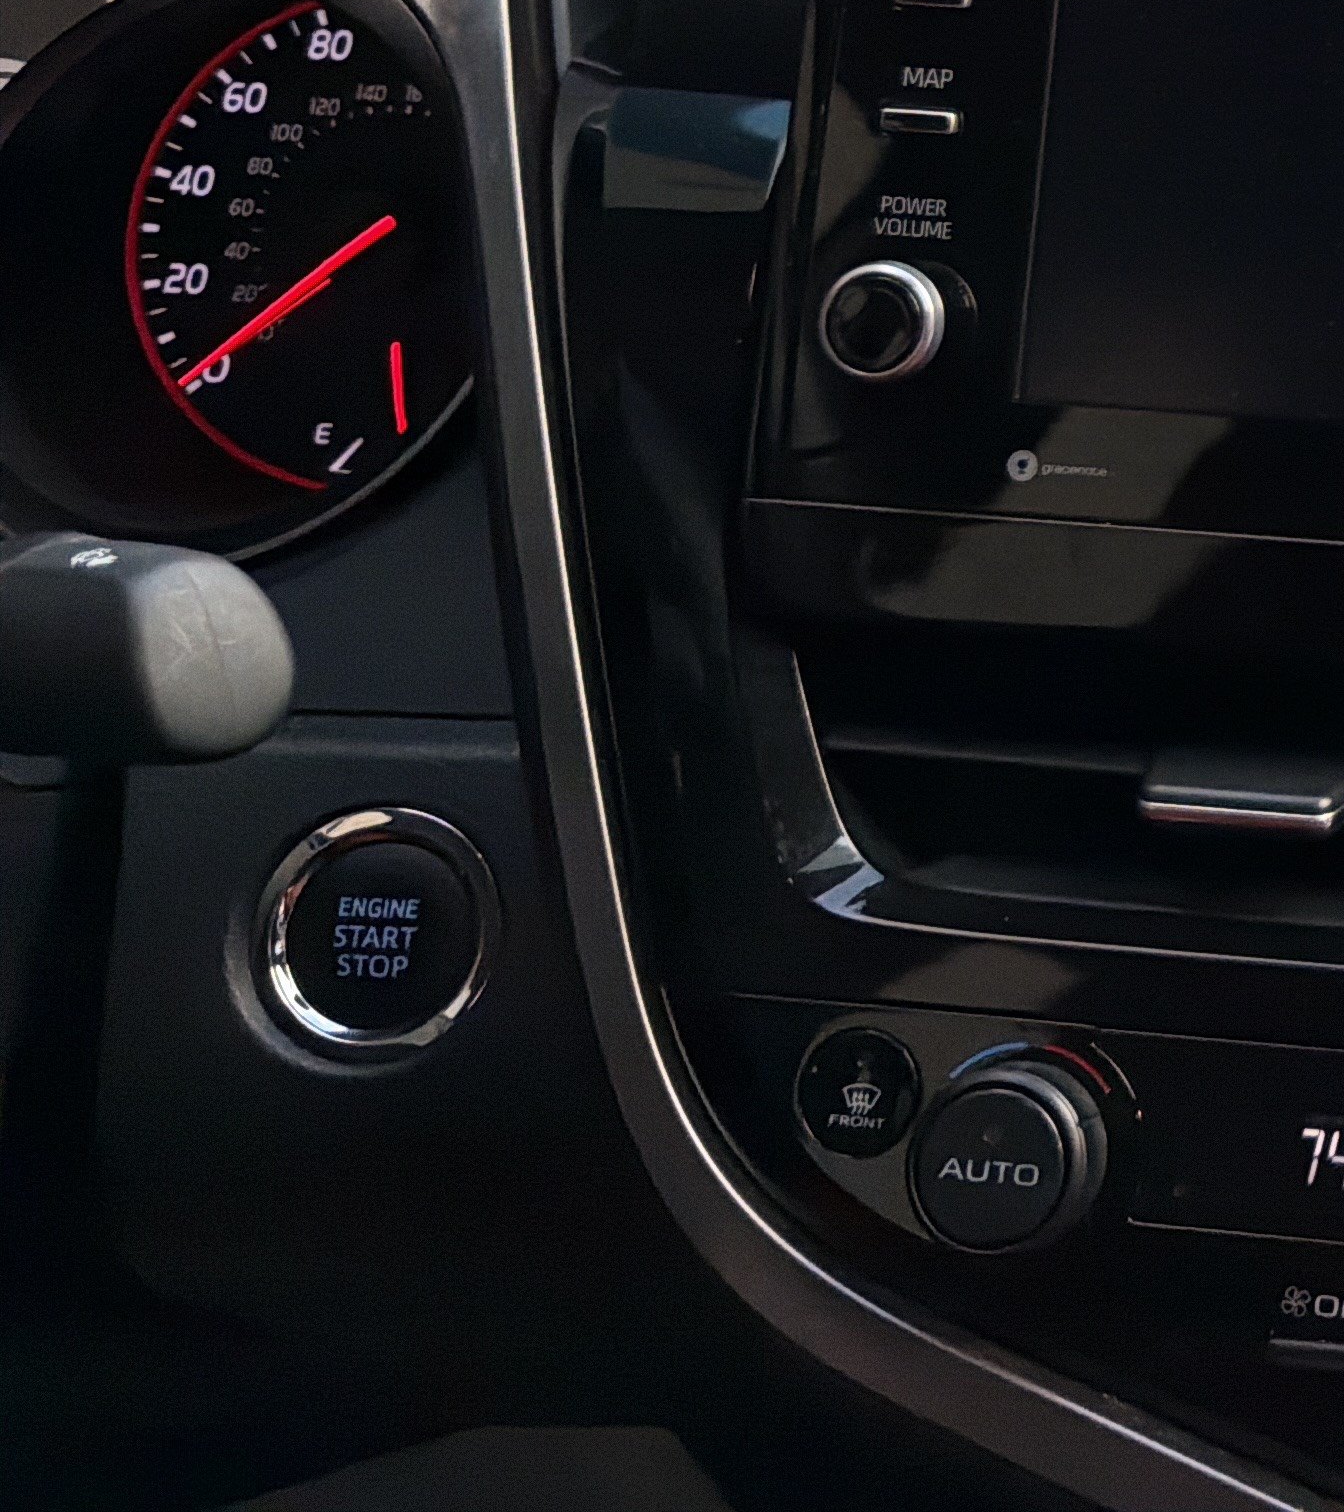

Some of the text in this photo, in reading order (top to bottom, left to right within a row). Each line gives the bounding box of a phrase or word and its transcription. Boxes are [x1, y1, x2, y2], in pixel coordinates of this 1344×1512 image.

[307, 29, 353, 61] 80
[902, 66, 954, 89] MAP
[222, 82, 267, 113] 60
[309, 97, 341, 116] 120
[270, 124, 303, 141] 100
[247, 158, 273, 175] 80
[169, 165, 215, 196] 40
[228, 198, 255, 217] 60
[880, 195, 948, 218] POWER
[874, 217, 953, 240] VOLUME
[224, 242, 250, 260] 40
[163, 263, 209, 295] 20
[231, 285, 258, 303] 20
[313, 423, 333, 445] E
[338, 897, 421, 920] ENGINE
[333, 925, 418, 950] START
[336, 954, 409, 979] STOP
[827, 1113, 885, 1130] FRONT
[938, 1157, 1040, 1187] AUTO
